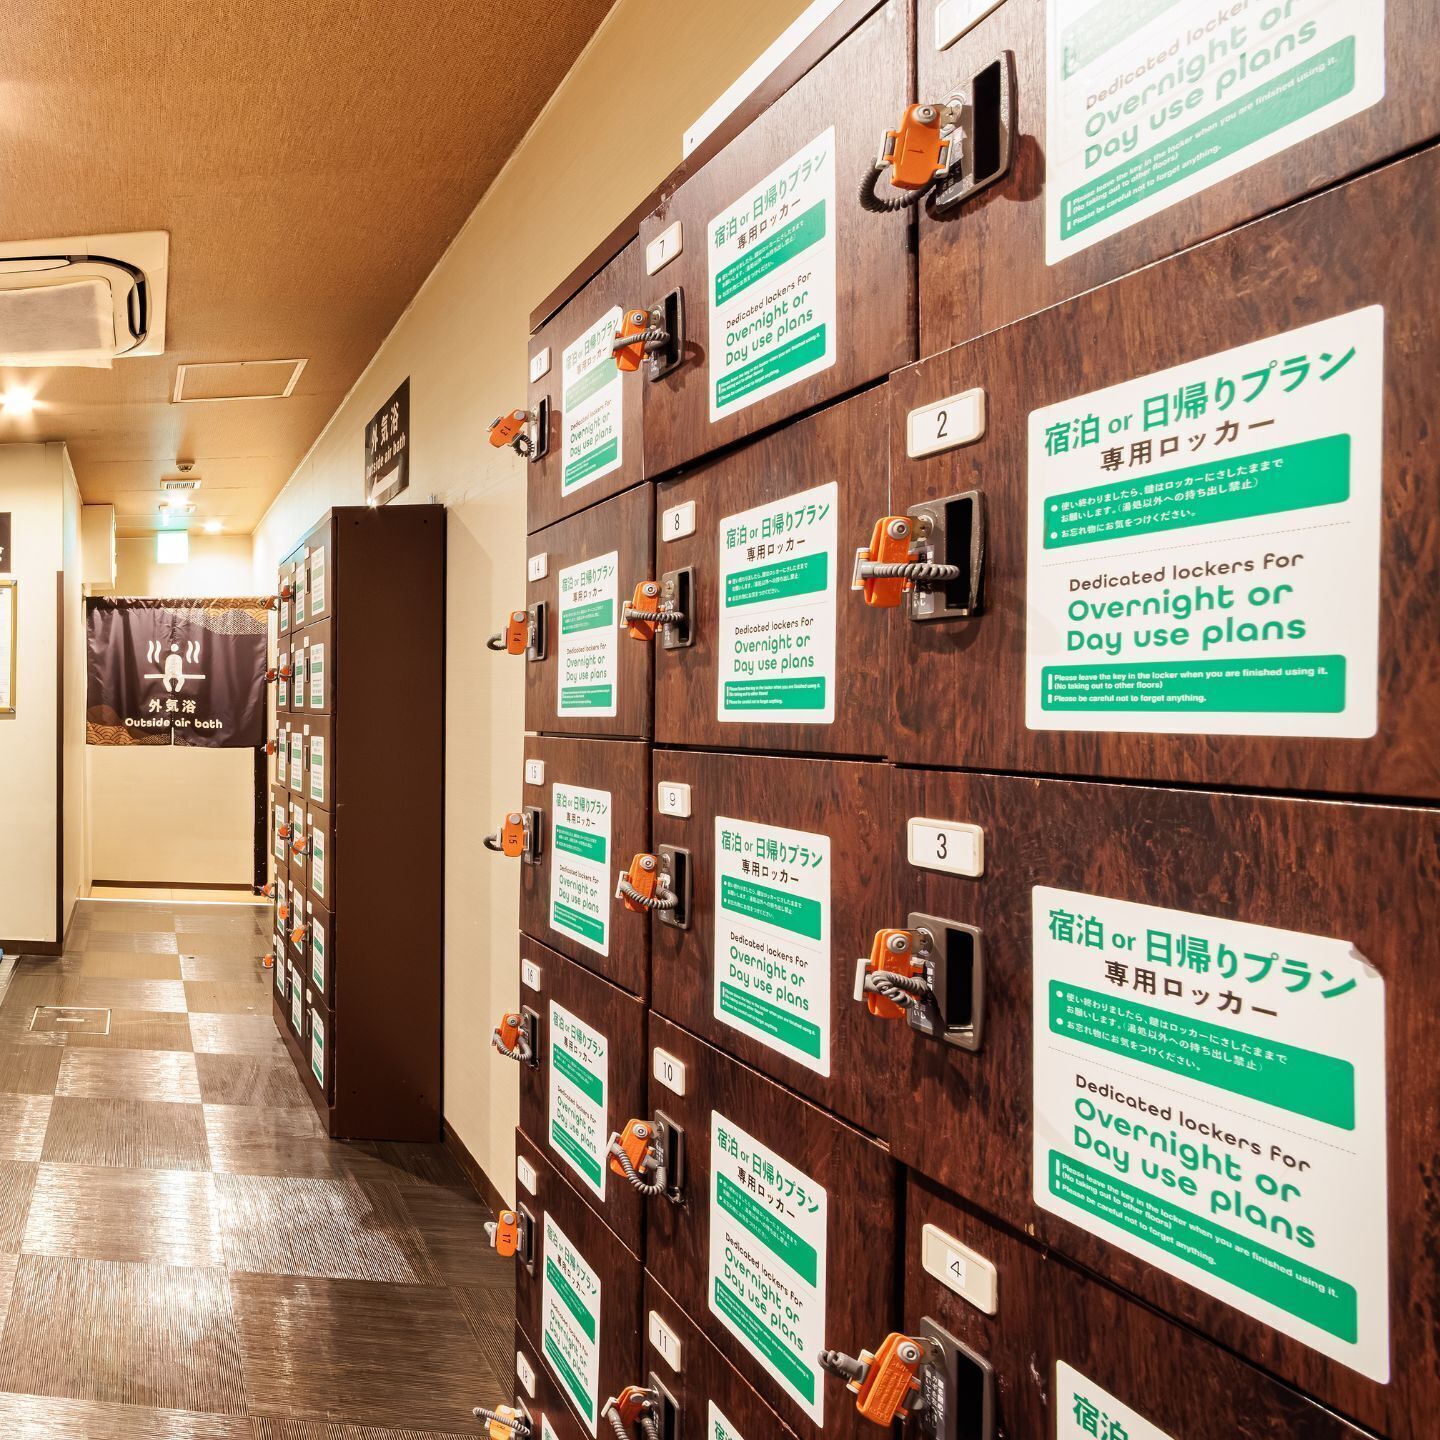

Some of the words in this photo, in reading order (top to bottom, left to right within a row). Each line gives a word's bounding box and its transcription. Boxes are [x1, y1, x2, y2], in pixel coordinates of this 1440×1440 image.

[1085, 25, 1247, 137] Overnight
[1086, 37, 1180, 110] Dedicated
[1084, 123, 1138, 170] Day
[1149, 87, 1204, 131] use
[1215, 20, 1316, 101] plans
[714, 215, 738, 249] 宿泊
[739, 210, 750, 226] or
[752, 149, 827, 221] 日帰りプラン
[736, 198, 801, 250] 専用ロッカー
[659, 239, 666, 259] 7
[725, 300, 789, 347] Overnight
[792, 290, 809, 309] or
[726, 298, 764, 330] Dedicated
[765, 281, 795, 306] lockers
[797, 271, 812, 287] for
[725, 344, 748, 367] Day
[751, 331, 773, 352] use
[776, 308, 813, 343] plans
[1044, 412, 1100, 457] 宿泊
[1107, 413, 1133, 434] or
[1142, 346, 1356, 432] 日帰りプラン
[371, 401, 399, 455] 外気浴
[936, 410, 948, 439] 2
[384, 445, 392, 464] air
[392, 431, 406, 457] bath
[1100, 418, 1275, 472] 専用ロッカー
[674, 513, 681, 531] 8
[726, 523, 748, 550] 宿泊
[749, 527, 759, 539] or
[761, 502, 830, 540] 日帰りプラン
[746, 536, 806, 563] 専用ロッカー
[1069, 566, 1166, 592] Dedicated
[1172, 559, 1255, 581] lockers
[1263, 552, 1304, 570] for
[1067, 584, 1235, 622] Overnight
[1247, 583, 1294, 607] or
[513, 632, 522, 643] 14
[734, 621, 770, 636] Dedicated
[770, 619, 799, 631] lockers
[800, 616, 814, 627] for
[734, 633, 792, 655] Overnight
[795, 634, 811, 648] or
[1066, 629, 1122, 656] Day
[1133, 627, 1190, 648] use
[1202, 616, 1306, 652] plans
[733, 658, 755, 676] Day
[757, 658, 778, 671] use
[780, 652, 815, 674] plans
[1053, 674, 1077, 682] Please
[1112, 672, 1127, 681] key
[1151, 671, 1178, 679] locker
[1180, 670, 1204, 678] when
[1205, 671, 1223, 679] you
[1242, 668, 1283, 677] finished
[1285, 667, 1315, 677] using
[1317, 667, 1328, 675] it.
[1053, 682, 1067, 690] (No
[1067, 682, 1090, 691] taking
[1113, 681, 1135, 689] other
[1136, 680, 1163, 689] floors)
[1053, 694, 1077, 702] Please
[1088, 694, 1115, 702] careful
[1140, 694, 1165, 704] forget
[1166, 694, 1207, 703] anything.
[124, 717, 170, 727] Outside
[174, 717, 191, 727] air
[194, 718, 223, 729] bath
[148, 698, 196, 713] 外気浴
[669, 792, 676, 808] 9
[509, 834, 518, 846] 15
[721, 829, 742, 854] 宿泊
[743, 841, 754, 852] or
[755, 836, 823, 869] 日帰りプラン
[936, 833, 947, 860] 3
[741, 858, 799, 884] 専用ロッカー
[729, 945, 787, 987] Overnight
[790, 972, 805, 988] or
[730, 931, 765, 952] Dedicated
[765, 943, 793, 964] lockers
[794, 955, 809, 969] for
[1048, 908, 1104, 951] 宿泊
[1111, 932, 1137, 951] or
[1146, 928, 1357, 999] 日帰りプラン
[527, 968, 534, 984] 16
[729, 962, 750, 989] Day
[752, 976, 773, 995] use
[775, 984, 809, 1011] plans
[1104, 959, 1278, 1017] 専用ロッカー
[663, 1062, 673, 1083] 10
[1075, 1073, 1172, 1121] Dedicated
[1179, 1110, 1262, 1156] lockers
[1269, 1144, 1311, 1172] for
[1074, 1097, 1242, 1193] Overnight
[1255, 1173, 1301, 1202] or
[522, 1167, 530, 1184] 17
[717, 1126, 739, 1160] 宿泊
[739, 1150, 750, 1164] or
[751, 1151, 820, 1214] 日帰りプラン
[1073, 1124, 1130, 1174] Day
[1140, 1158, 1198, 1197] use
[1210, 1189, 1315, 1249] plans
[737, 1165, 795, 1219] 専用ロッカー
[502, 1233, 512, 1245] 17
[949, 1259, 962, 1278] 4
[659, 1329, 668, 1353] 11
